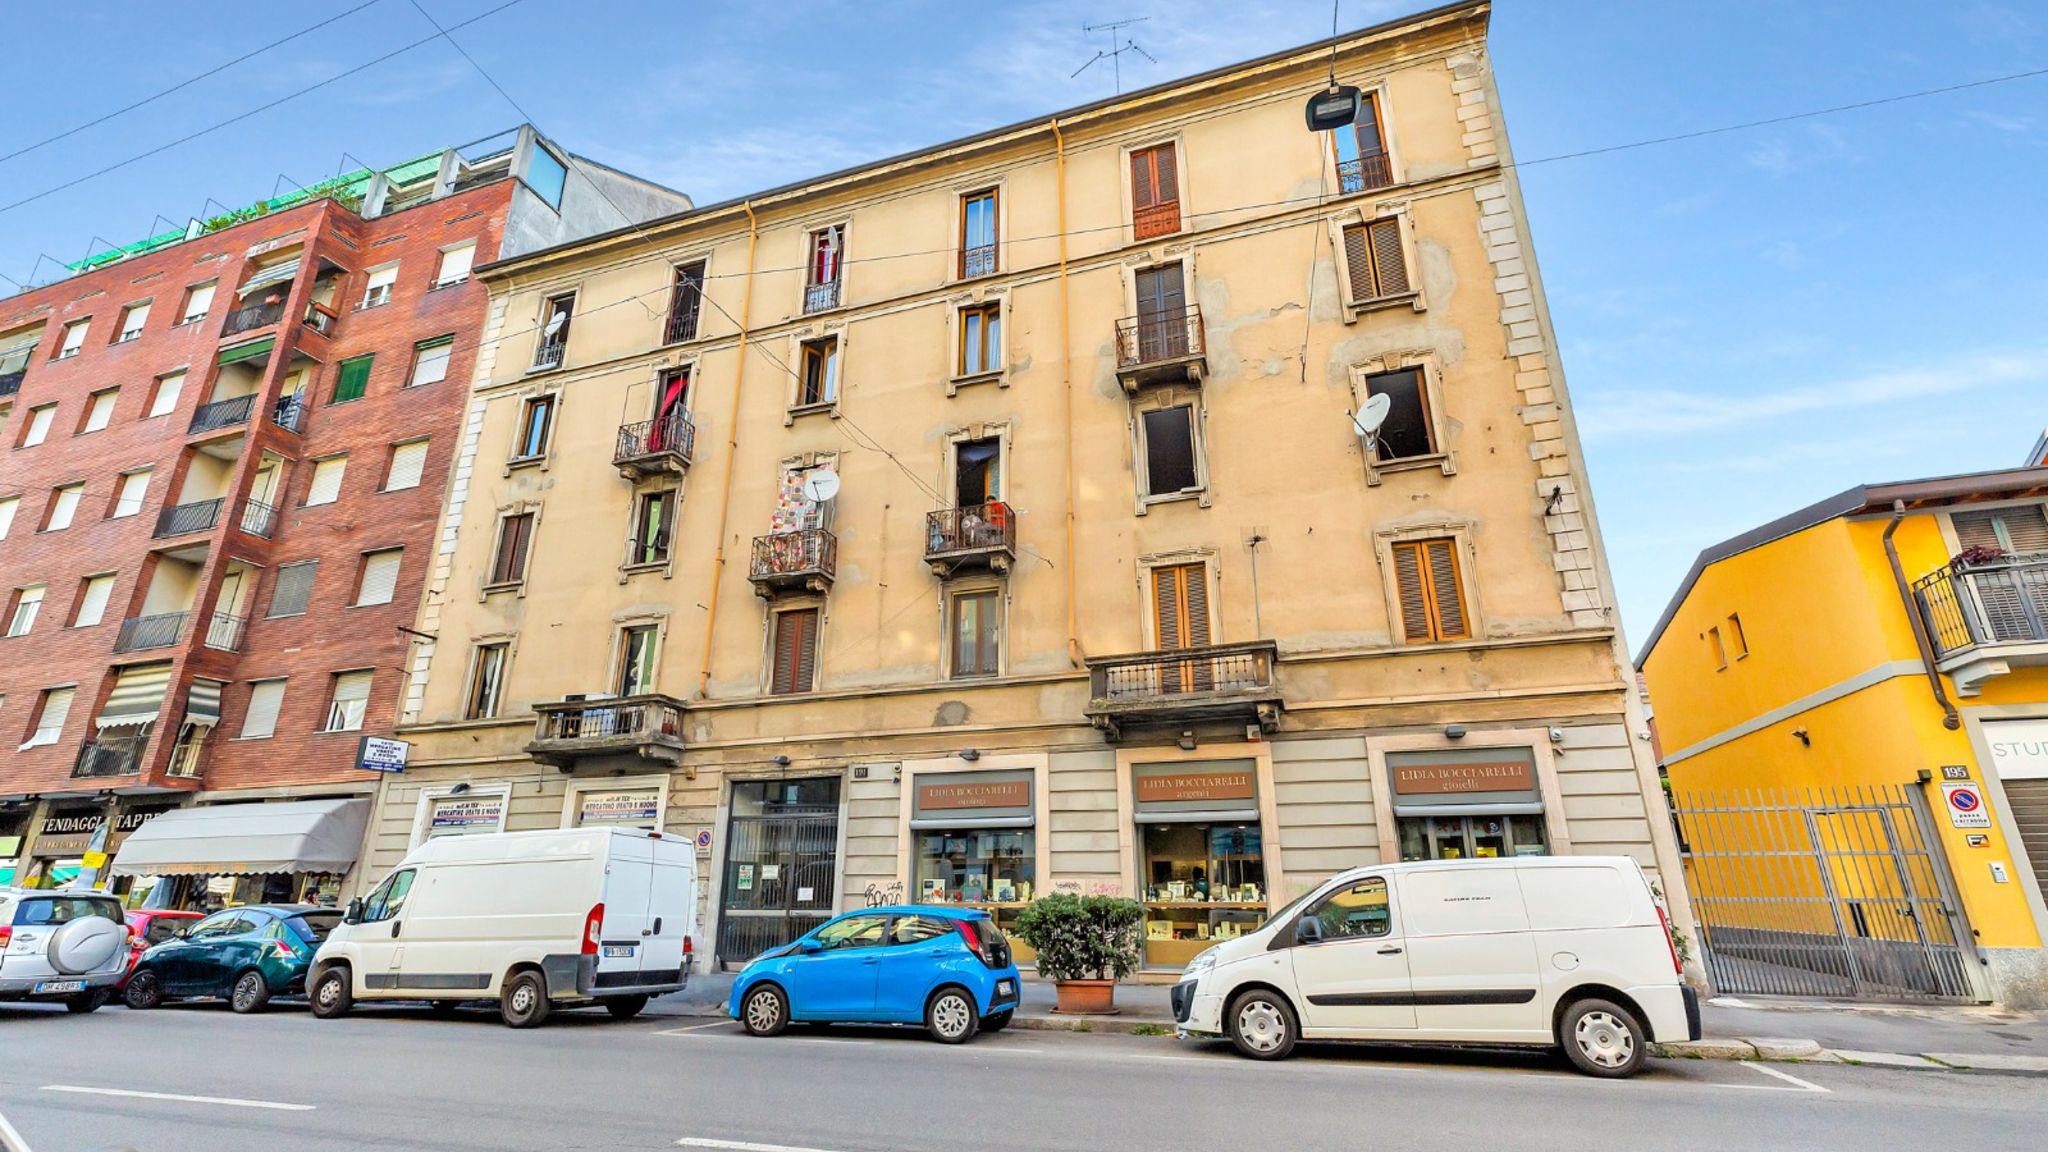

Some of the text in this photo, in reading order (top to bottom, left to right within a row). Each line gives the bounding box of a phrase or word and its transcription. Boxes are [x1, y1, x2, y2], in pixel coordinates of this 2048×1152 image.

[1401, 766, 1523, 780] LIDIA BOCCIARELLI
[1945, 767, 1967, 778] 195
